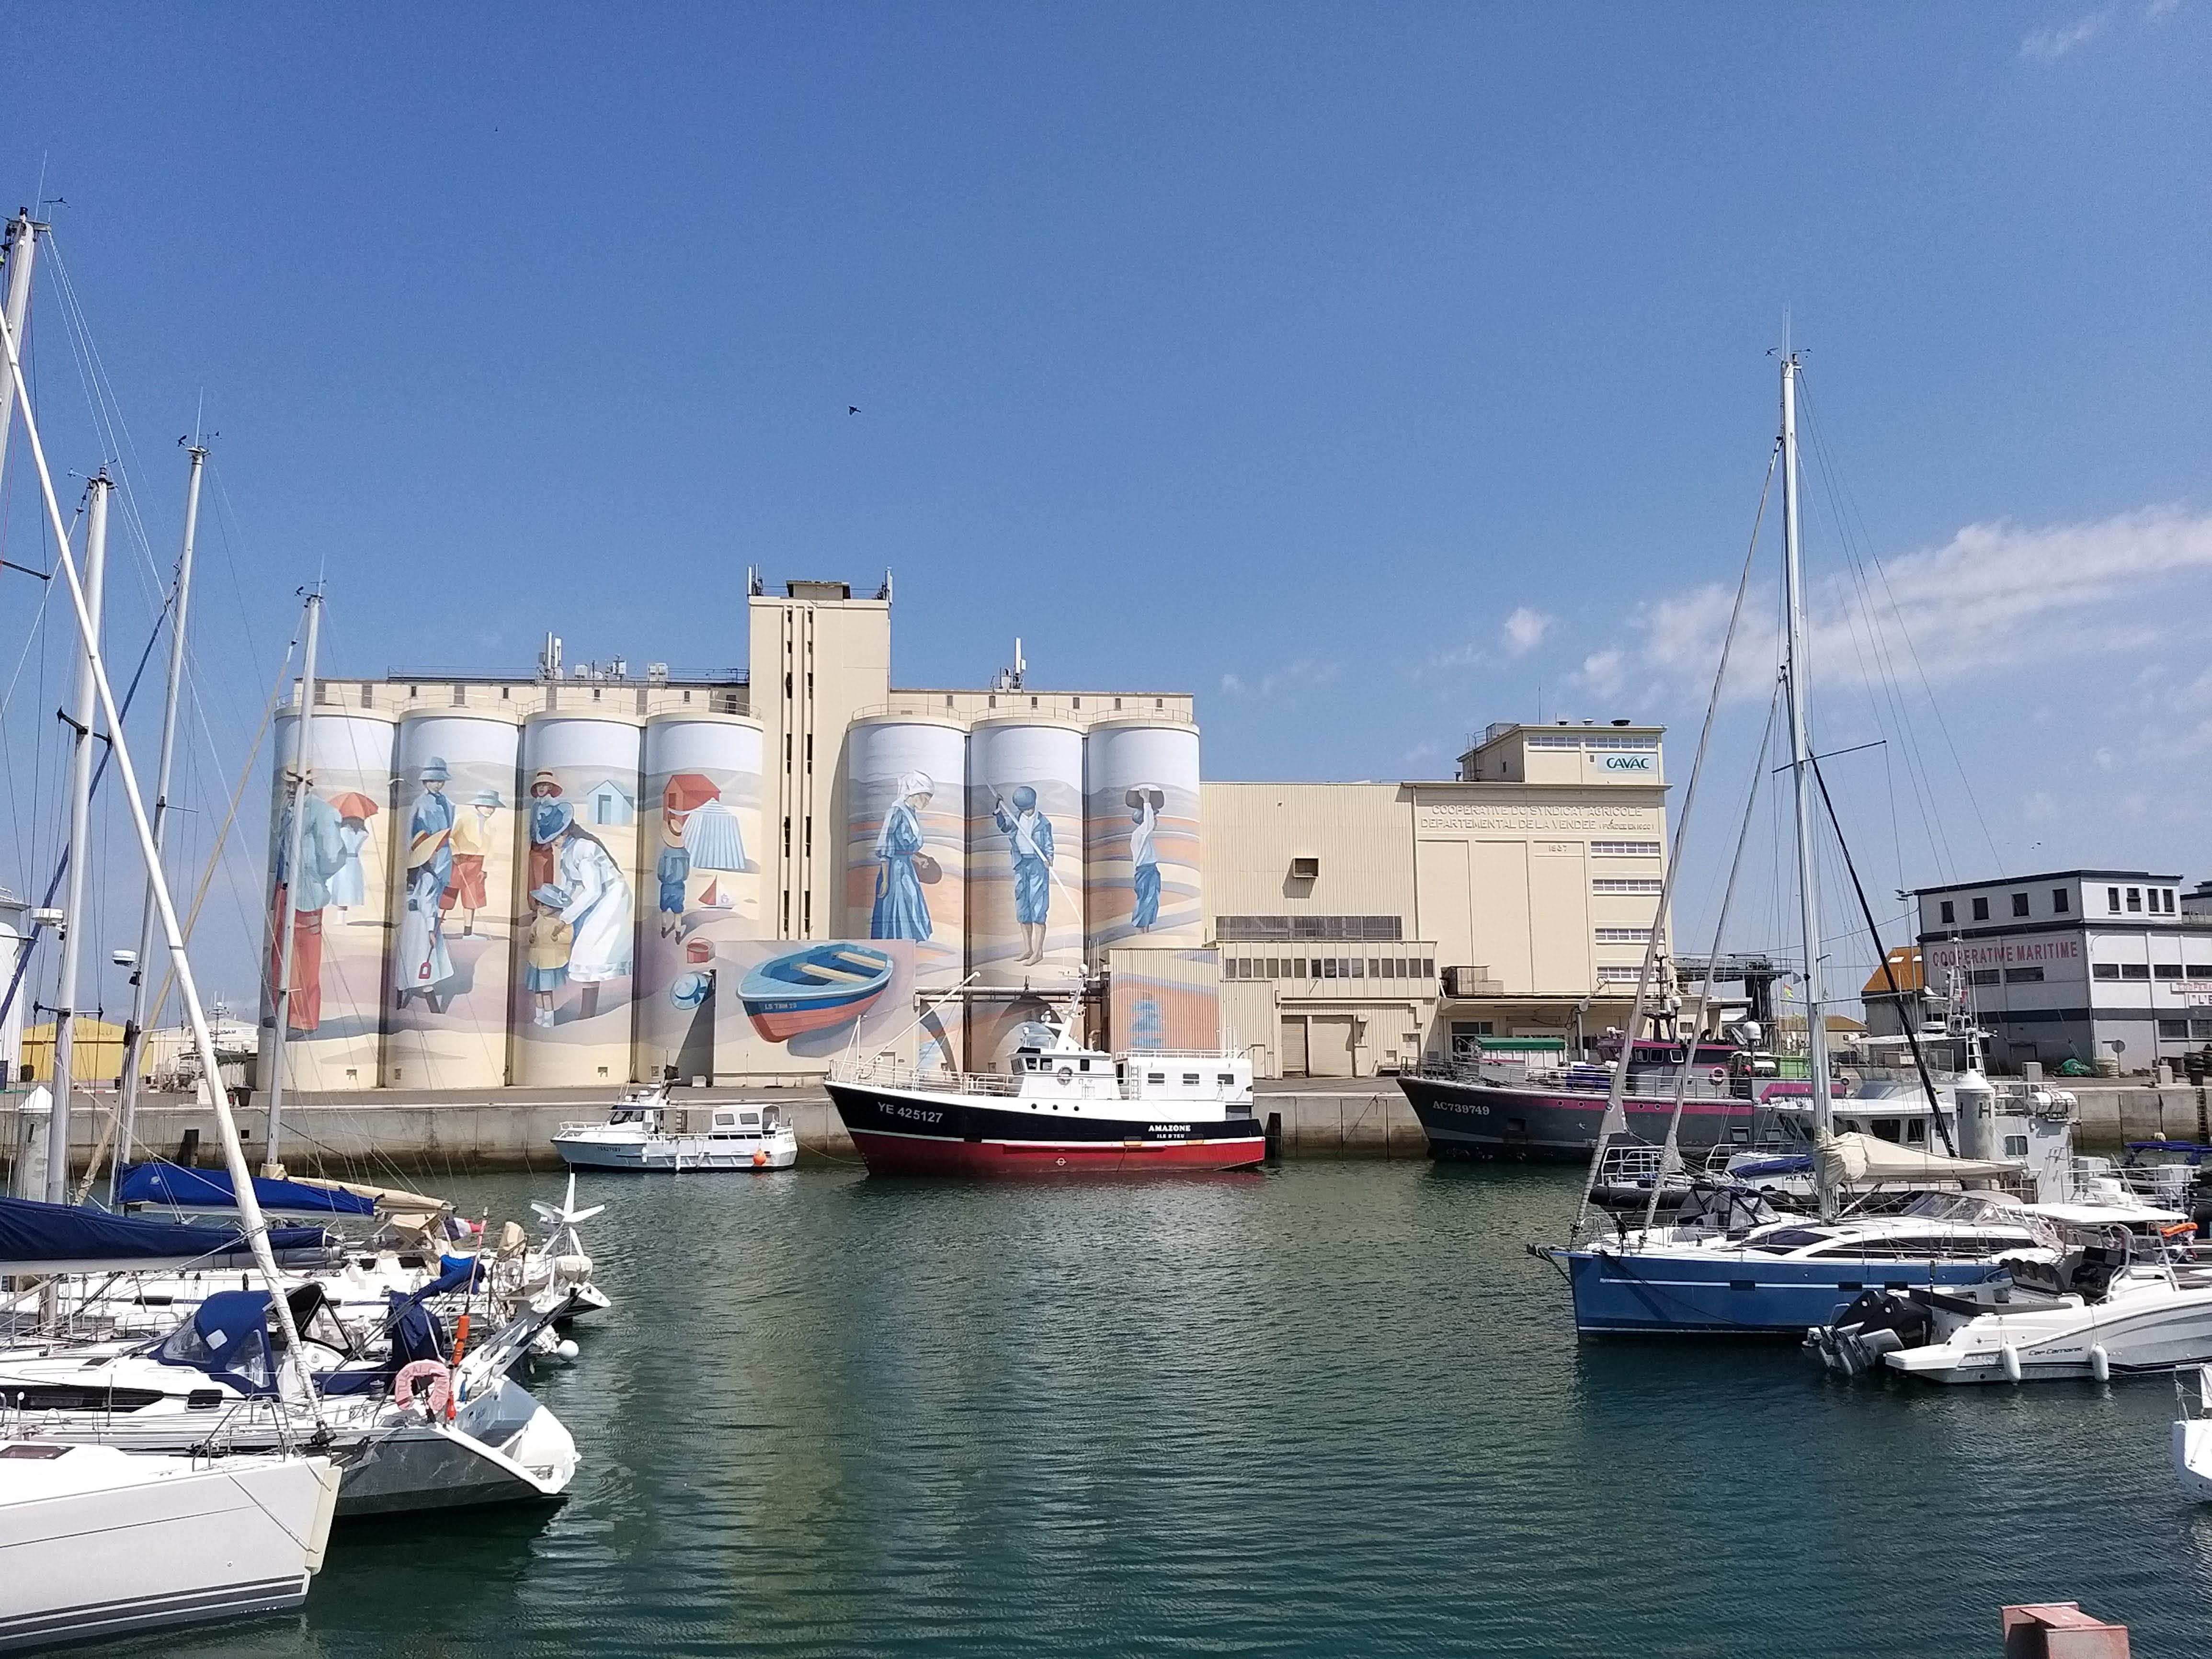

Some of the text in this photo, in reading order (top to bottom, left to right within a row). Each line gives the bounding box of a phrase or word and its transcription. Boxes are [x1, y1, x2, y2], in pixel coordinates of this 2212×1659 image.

[1607, 757, 1649, 769] CAVAC
[1432, 805, 1642, 817] COOPERATIVE DU SYNDICAT AGRICOLE
[1421, 818, 1516, 829] DEPARTEMENTAL
[1518, 818, 1534, 829] DE
[1535, 819, 1550, 829] LA
[1551, 819, 1596, 830] VENDEE
[1933, 941, 2078, 966] COOPERATIVE MARITIME
[877, 1102, 943, 1123] YE 425127
